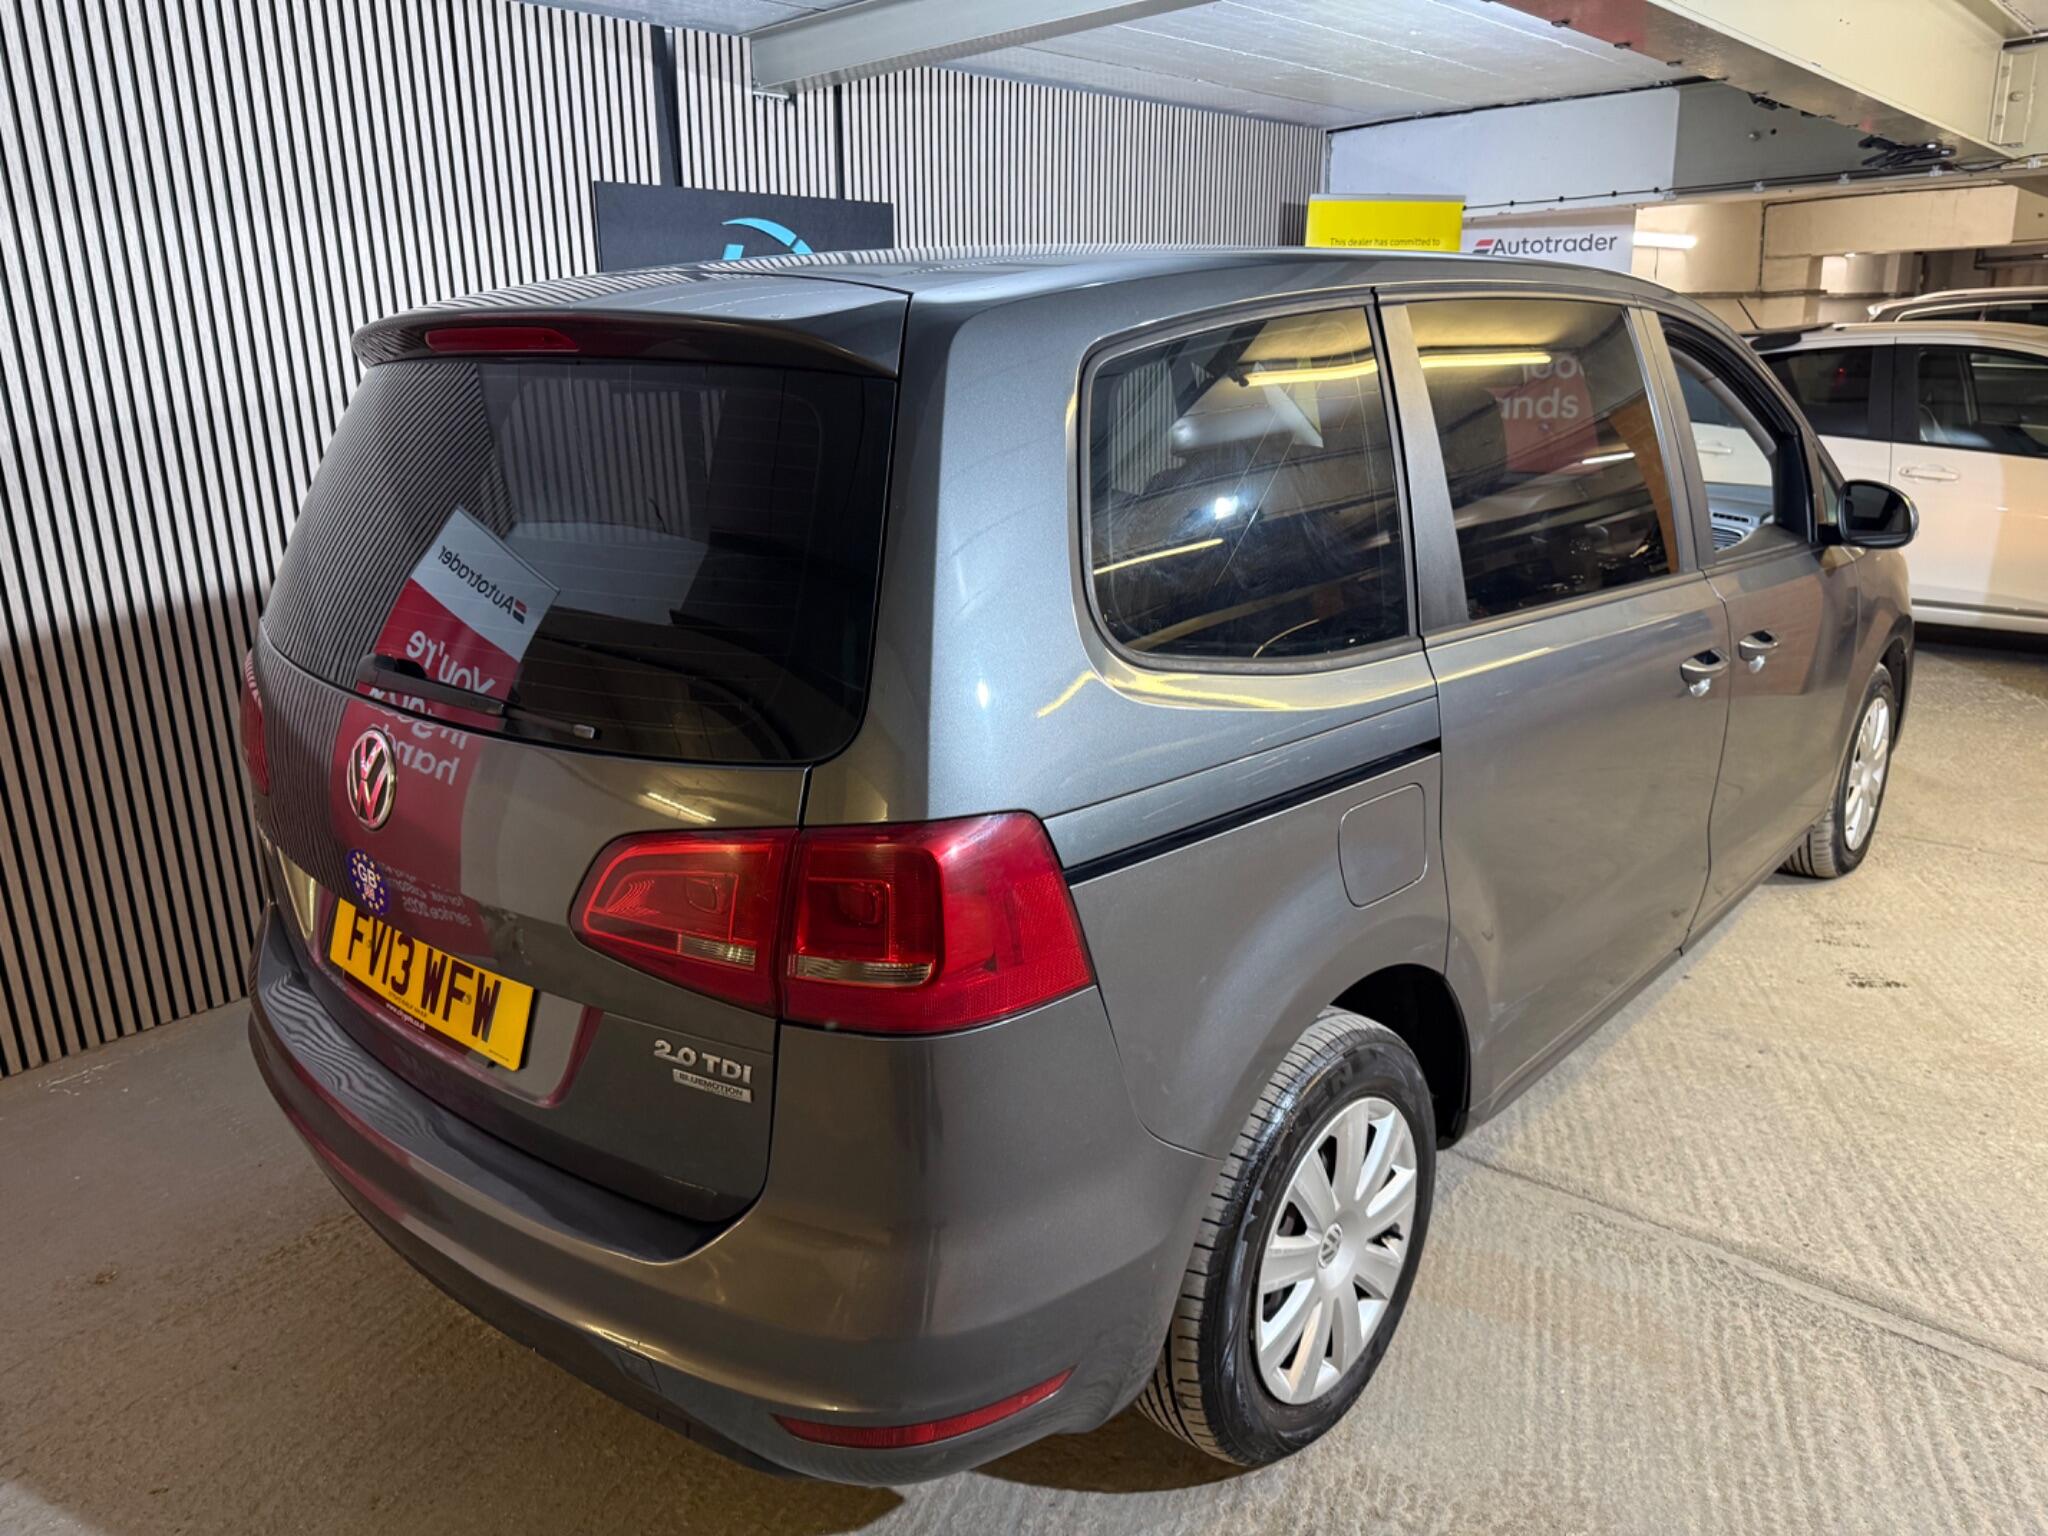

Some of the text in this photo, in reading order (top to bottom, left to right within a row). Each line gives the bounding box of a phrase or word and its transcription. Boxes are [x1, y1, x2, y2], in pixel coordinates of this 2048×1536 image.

[1330, 237, 1441, 247] This dealer has committed to
[1492, 234, 1618, 256] Autotrader
[357, 862, 378, 889] GB
[347, 910, 502, 1043] FV13 WFW
[702, 1052, 752, 1084] TDI
